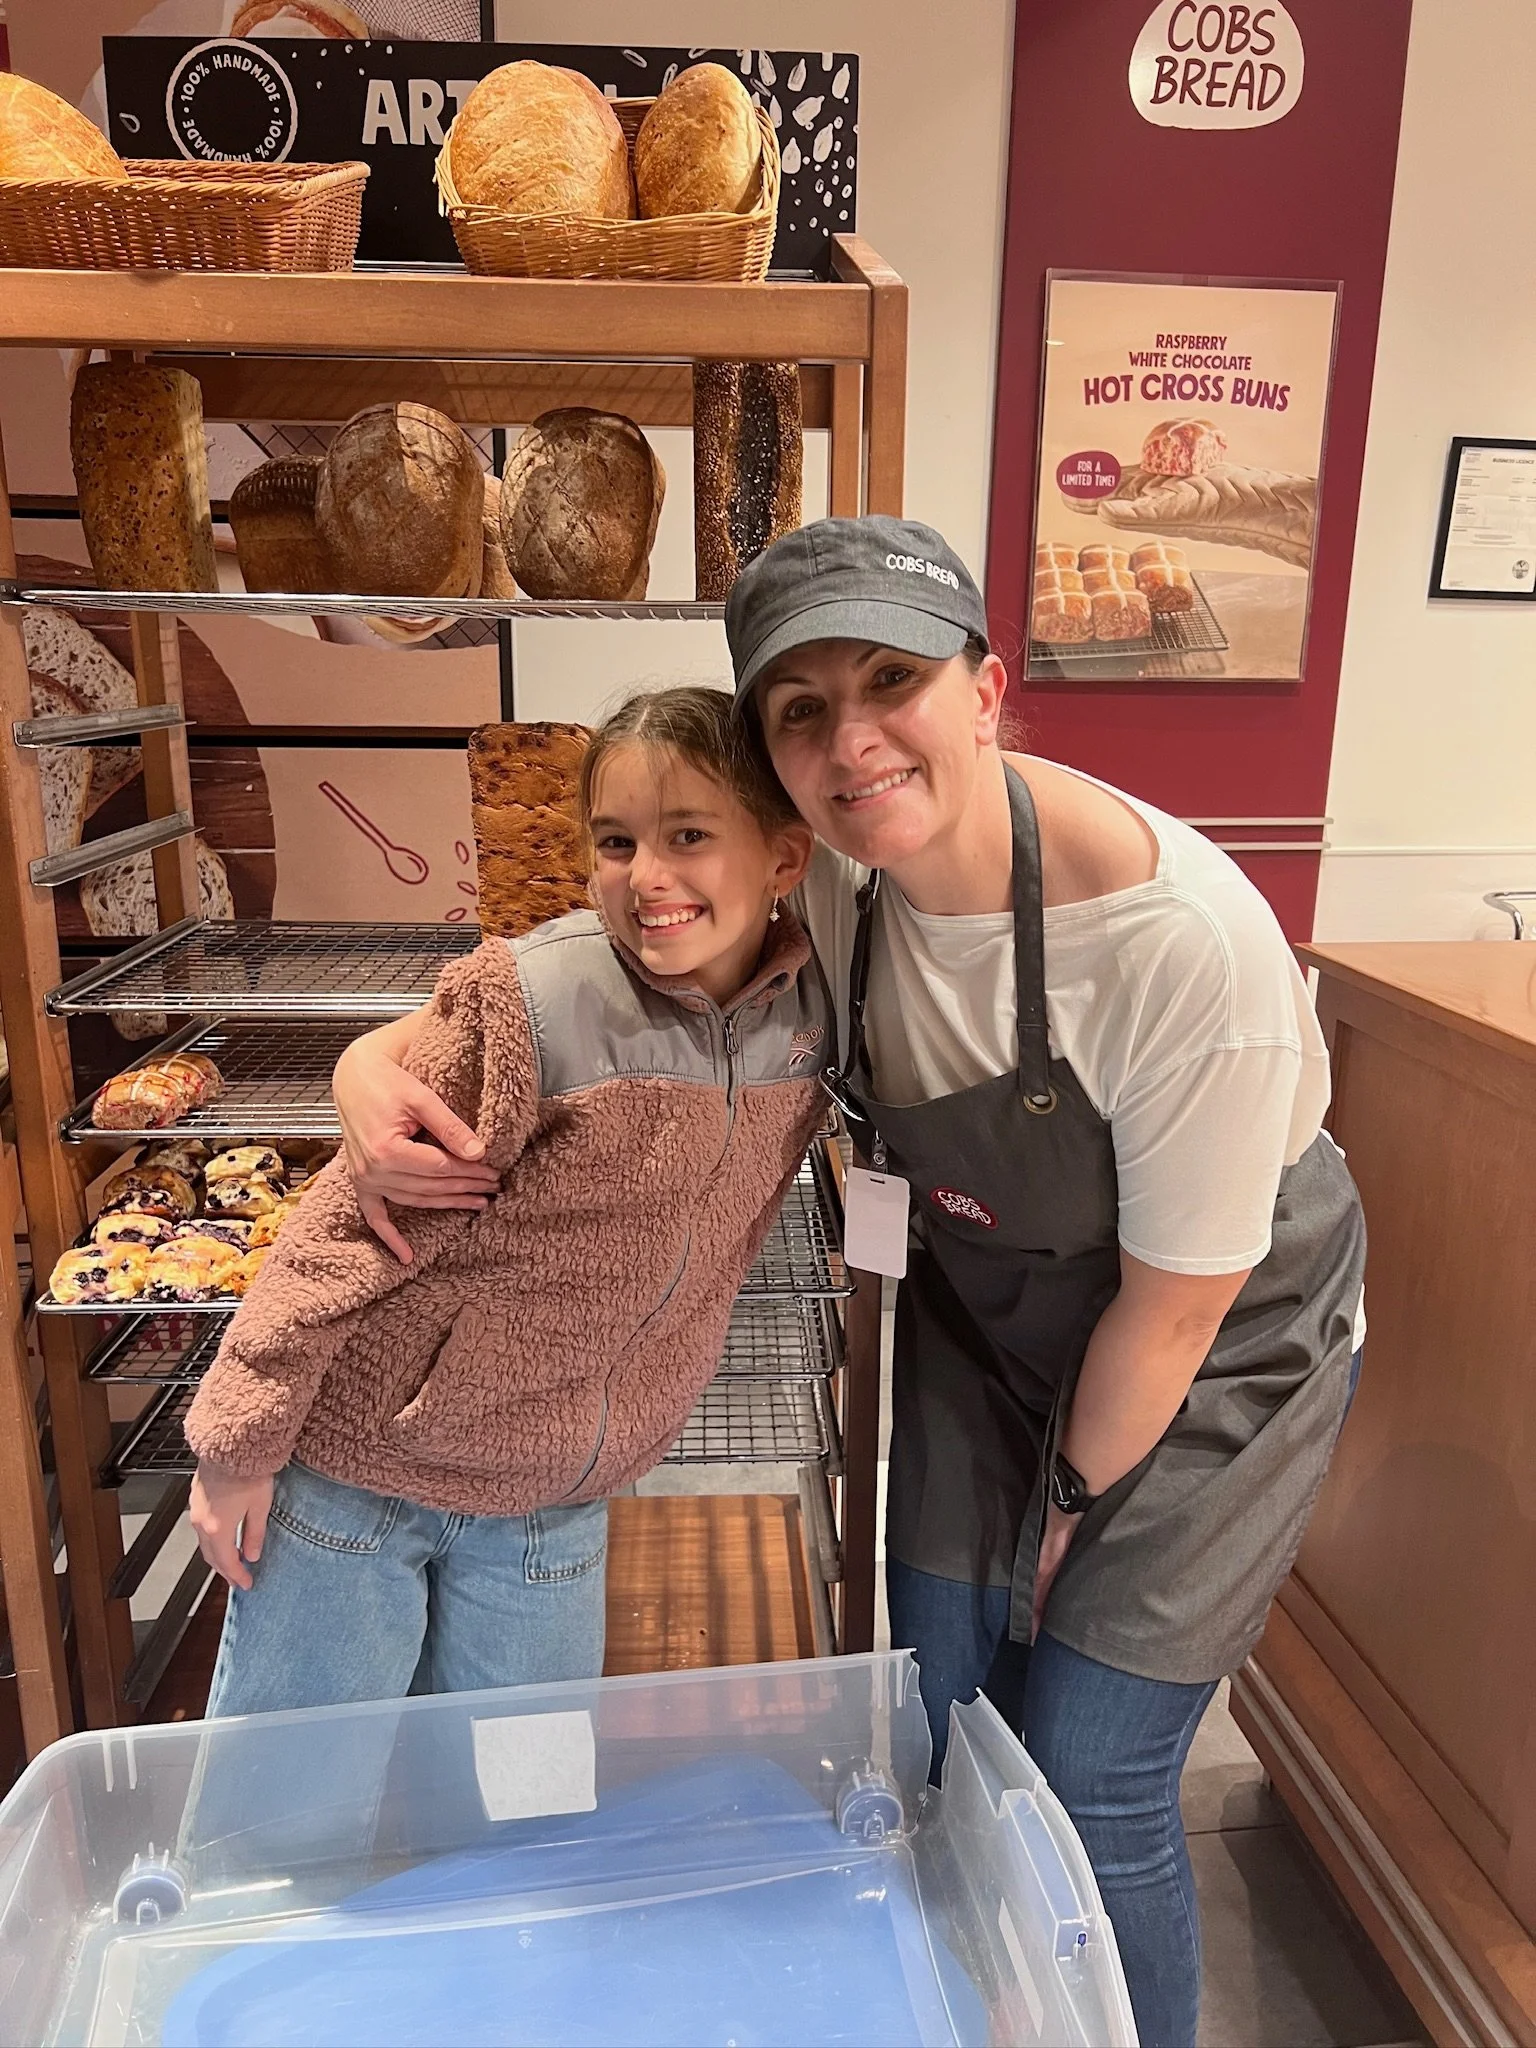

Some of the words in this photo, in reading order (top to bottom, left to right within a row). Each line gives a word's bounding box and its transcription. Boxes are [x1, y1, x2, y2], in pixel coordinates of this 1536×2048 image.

[1167, 0, 1276, 56] COBS
[181, 62, 210, 101] 100%
[212, 53, 280, 102] HANDMADE
[1150, 55, 1286, 111] BREAD
[254, 119, 284, 159] 100%
[1155, 334, 1227, 350] RASPBERRY
[1129, 351, 1167, 368] WHITE
[1171, 354, 1252, 371] CHOCOLATE
[1084, 374, 1134, 406] HOT
[1140, 373, 1225, 402] CROSS
[1230, 377, 1291, 412] BUNS
[1062, 474, 1092, 486] LIMITED
[1077, 460, 1093, 472] FOR
[1094, 461, 1101, 472] A
[886, 553, 925, 574] COBS
[926, 561, 960, 590] BREAD
[937, 1191, 981, 1211] COBS
